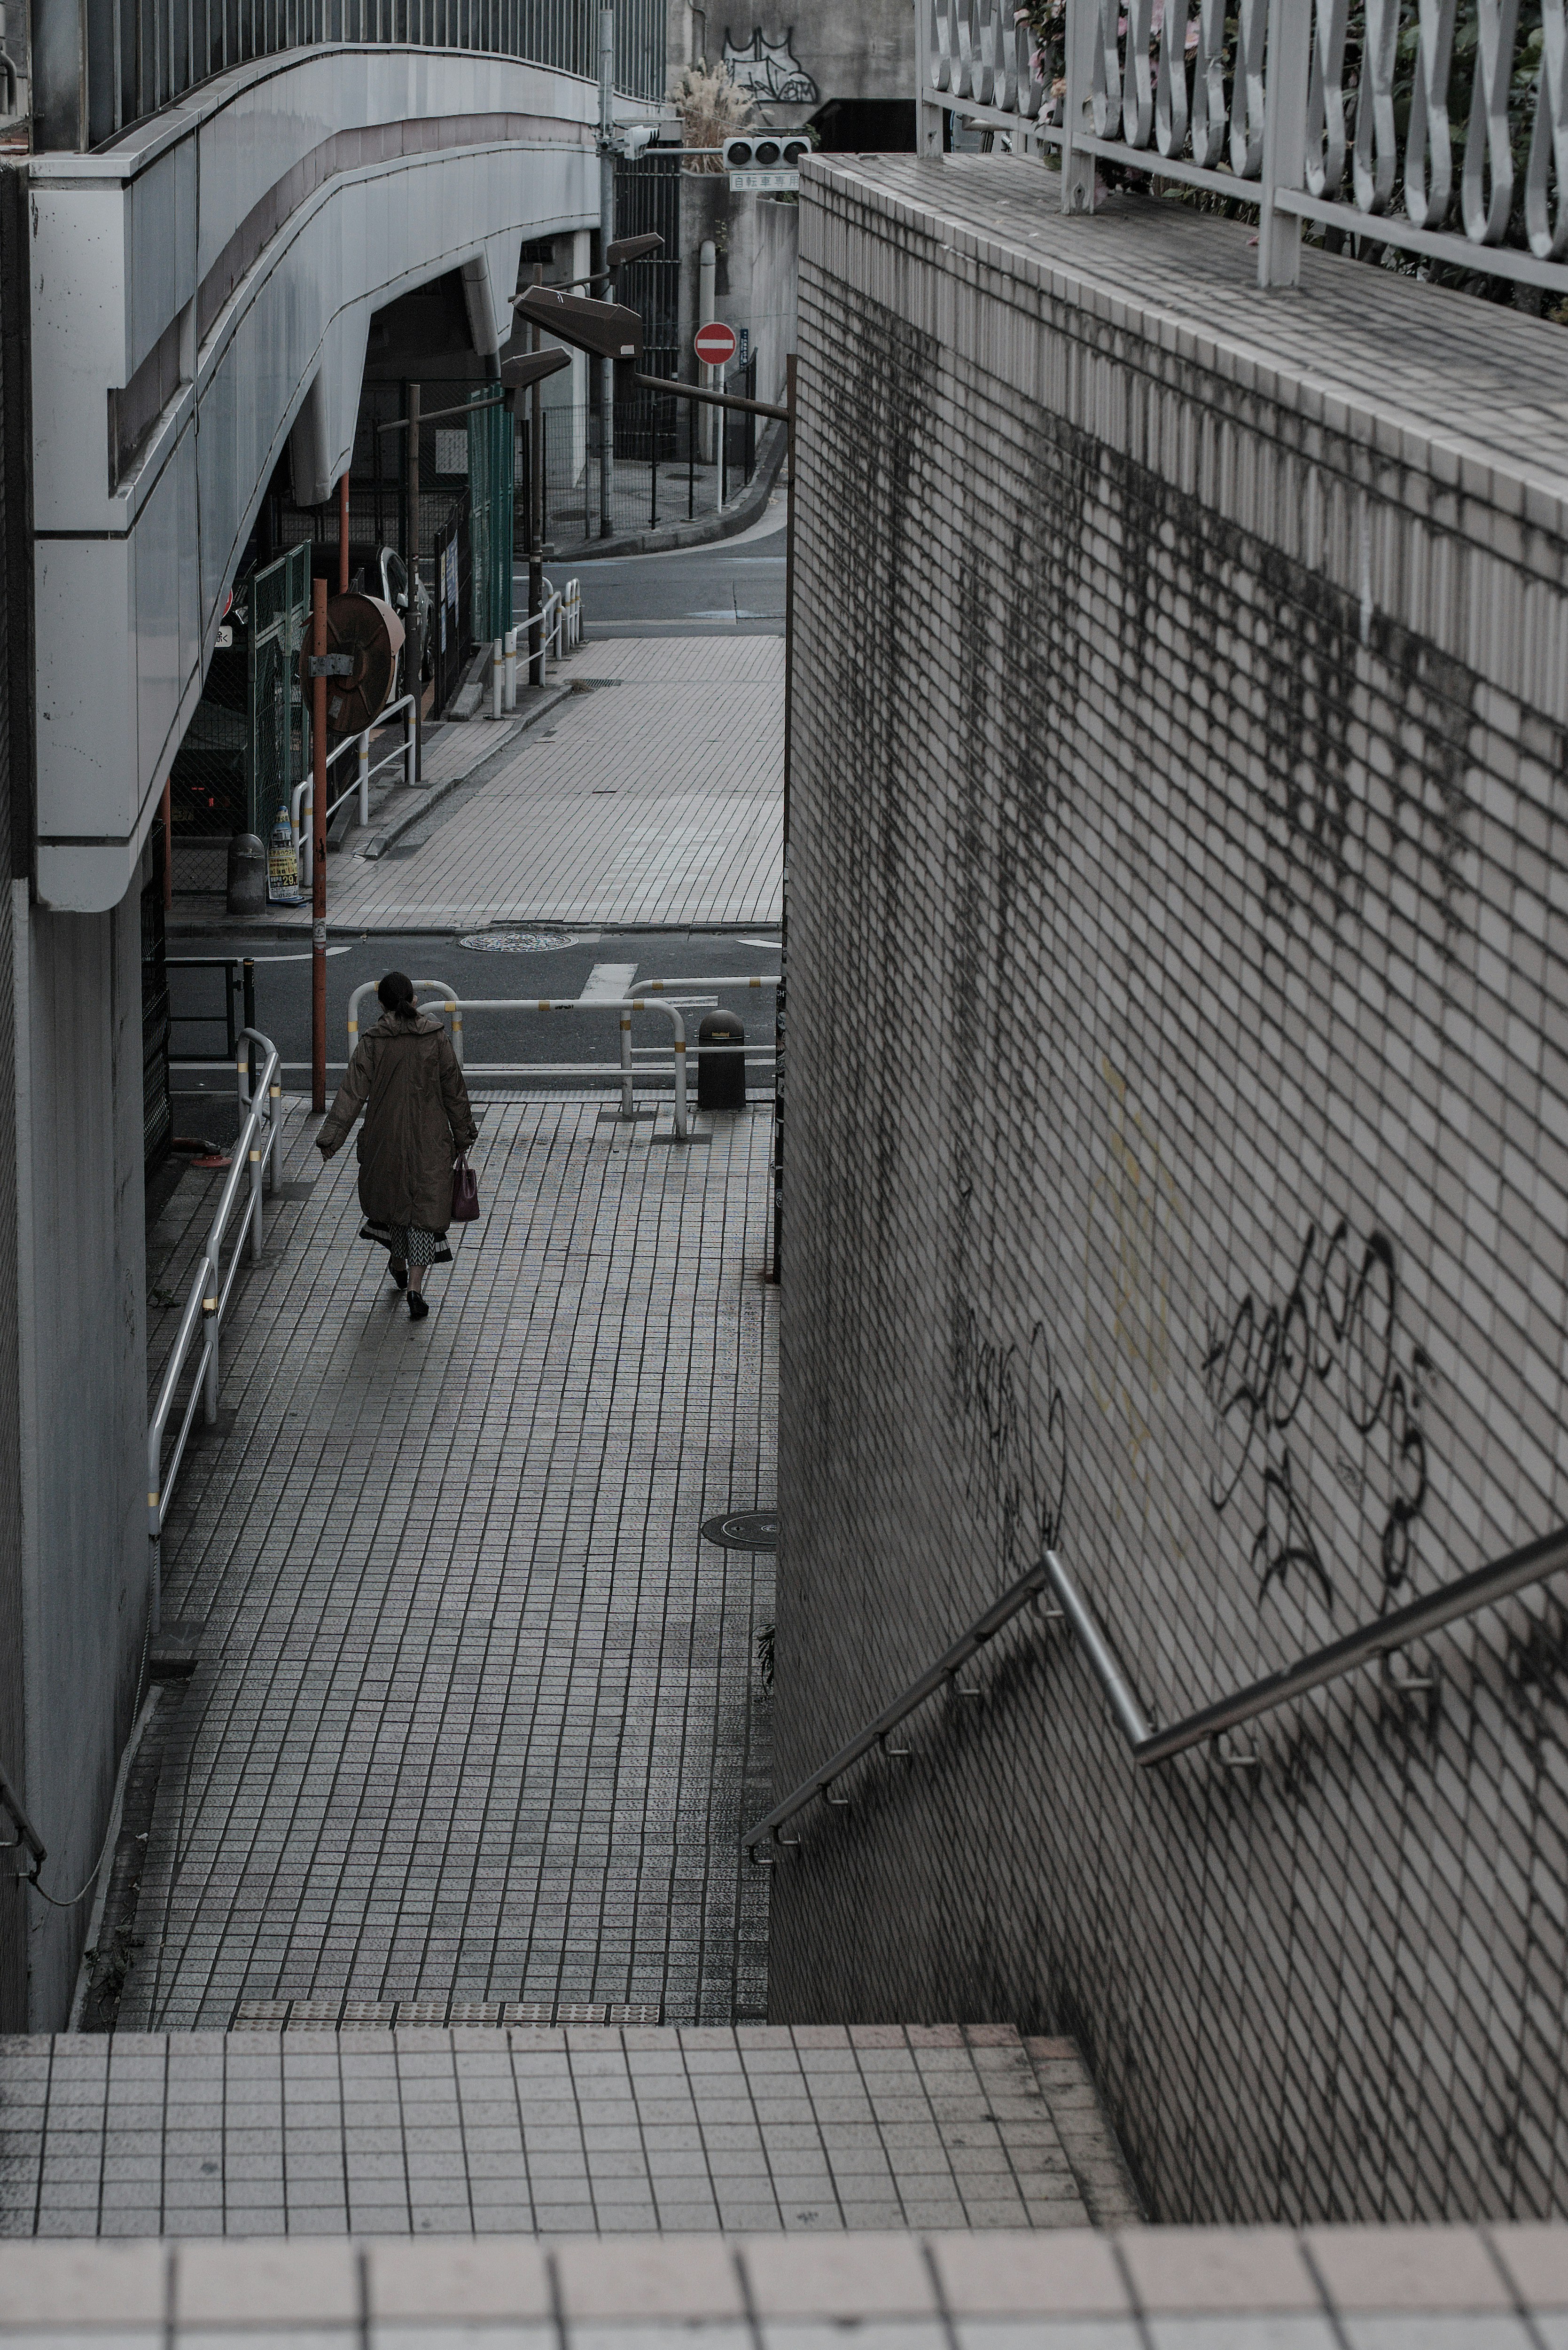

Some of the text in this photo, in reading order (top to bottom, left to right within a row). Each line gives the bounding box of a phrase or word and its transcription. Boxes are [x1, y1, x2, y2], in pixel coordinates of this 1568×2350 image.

[735, 176, 798, 188] 自転車専用
